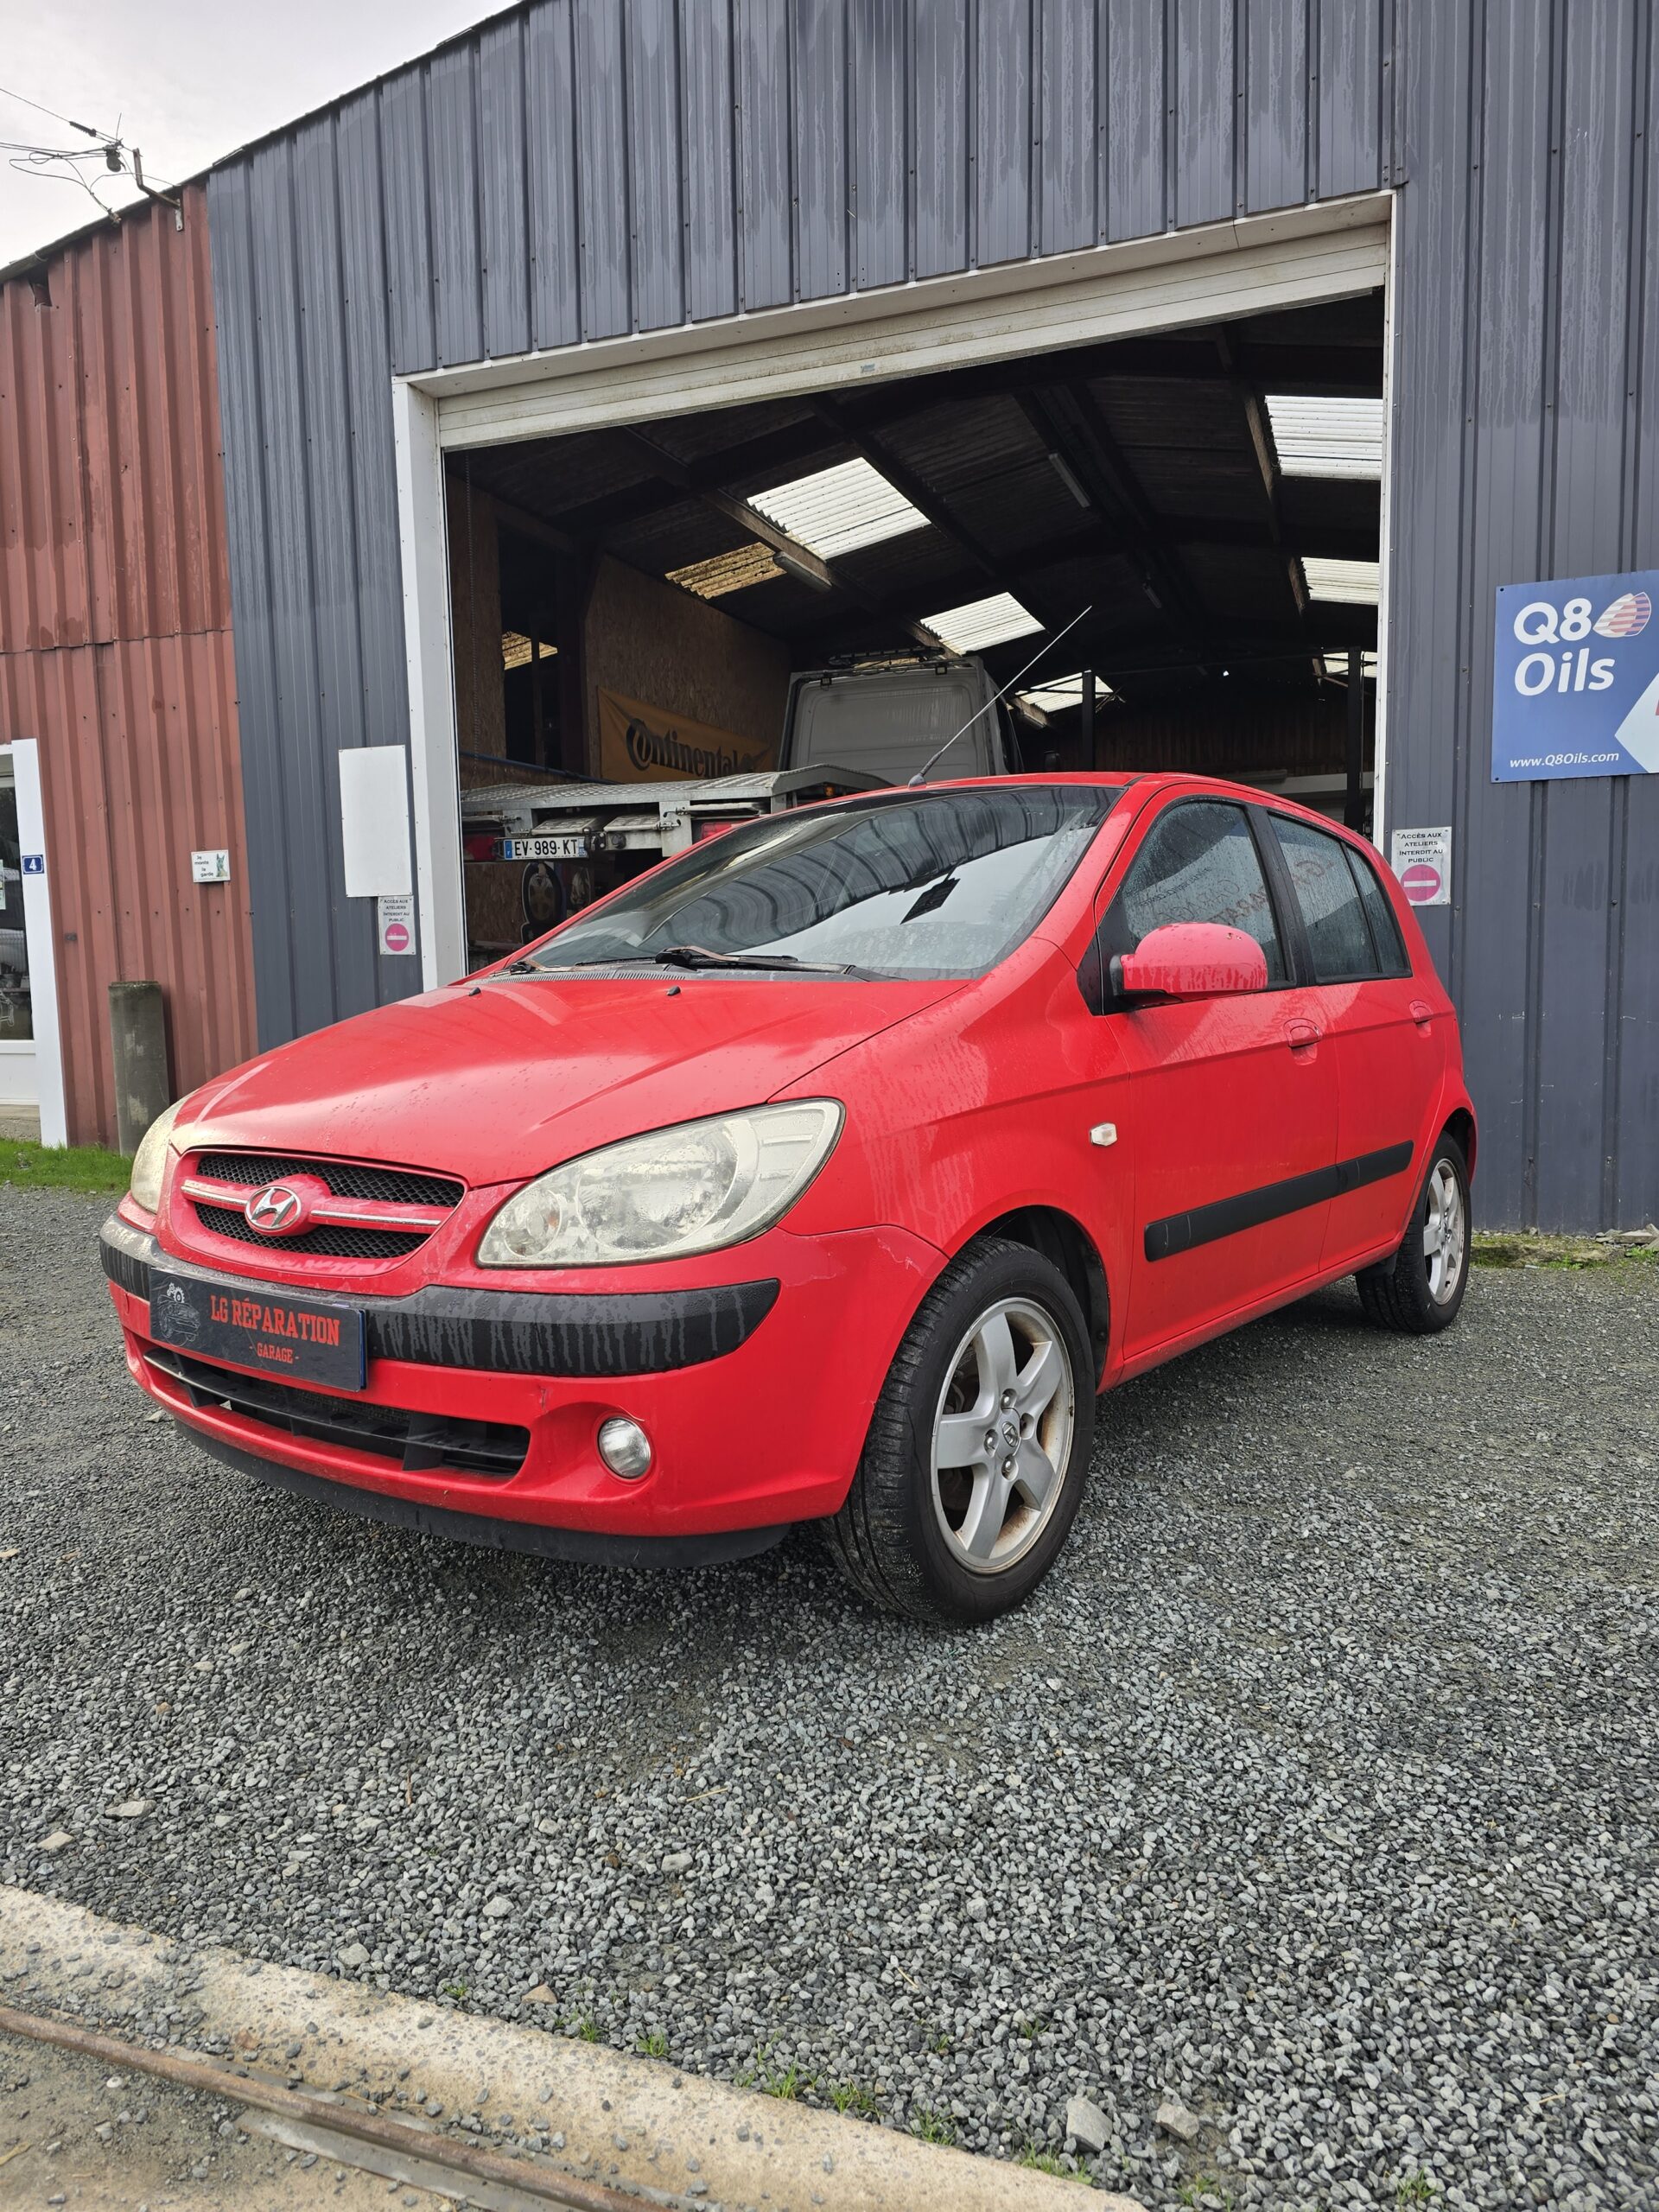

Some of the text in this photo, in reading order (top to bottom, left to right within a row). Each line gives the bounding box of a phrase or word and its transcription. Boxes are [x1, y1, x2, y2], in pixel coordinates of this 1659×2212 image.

[1514, 598, 1592, 645] Q8
[1515, 648, 1615, 696] Oils
[626, 718, 738, 778] Continental
[1510, 752, 1619, 767] www.Q8Oils.com
[29, 859, 37, 870] 4
[210, 1295, 340, 1346] LG RÉPARATION
[257, 1343, 293, 1364] GARAGE
